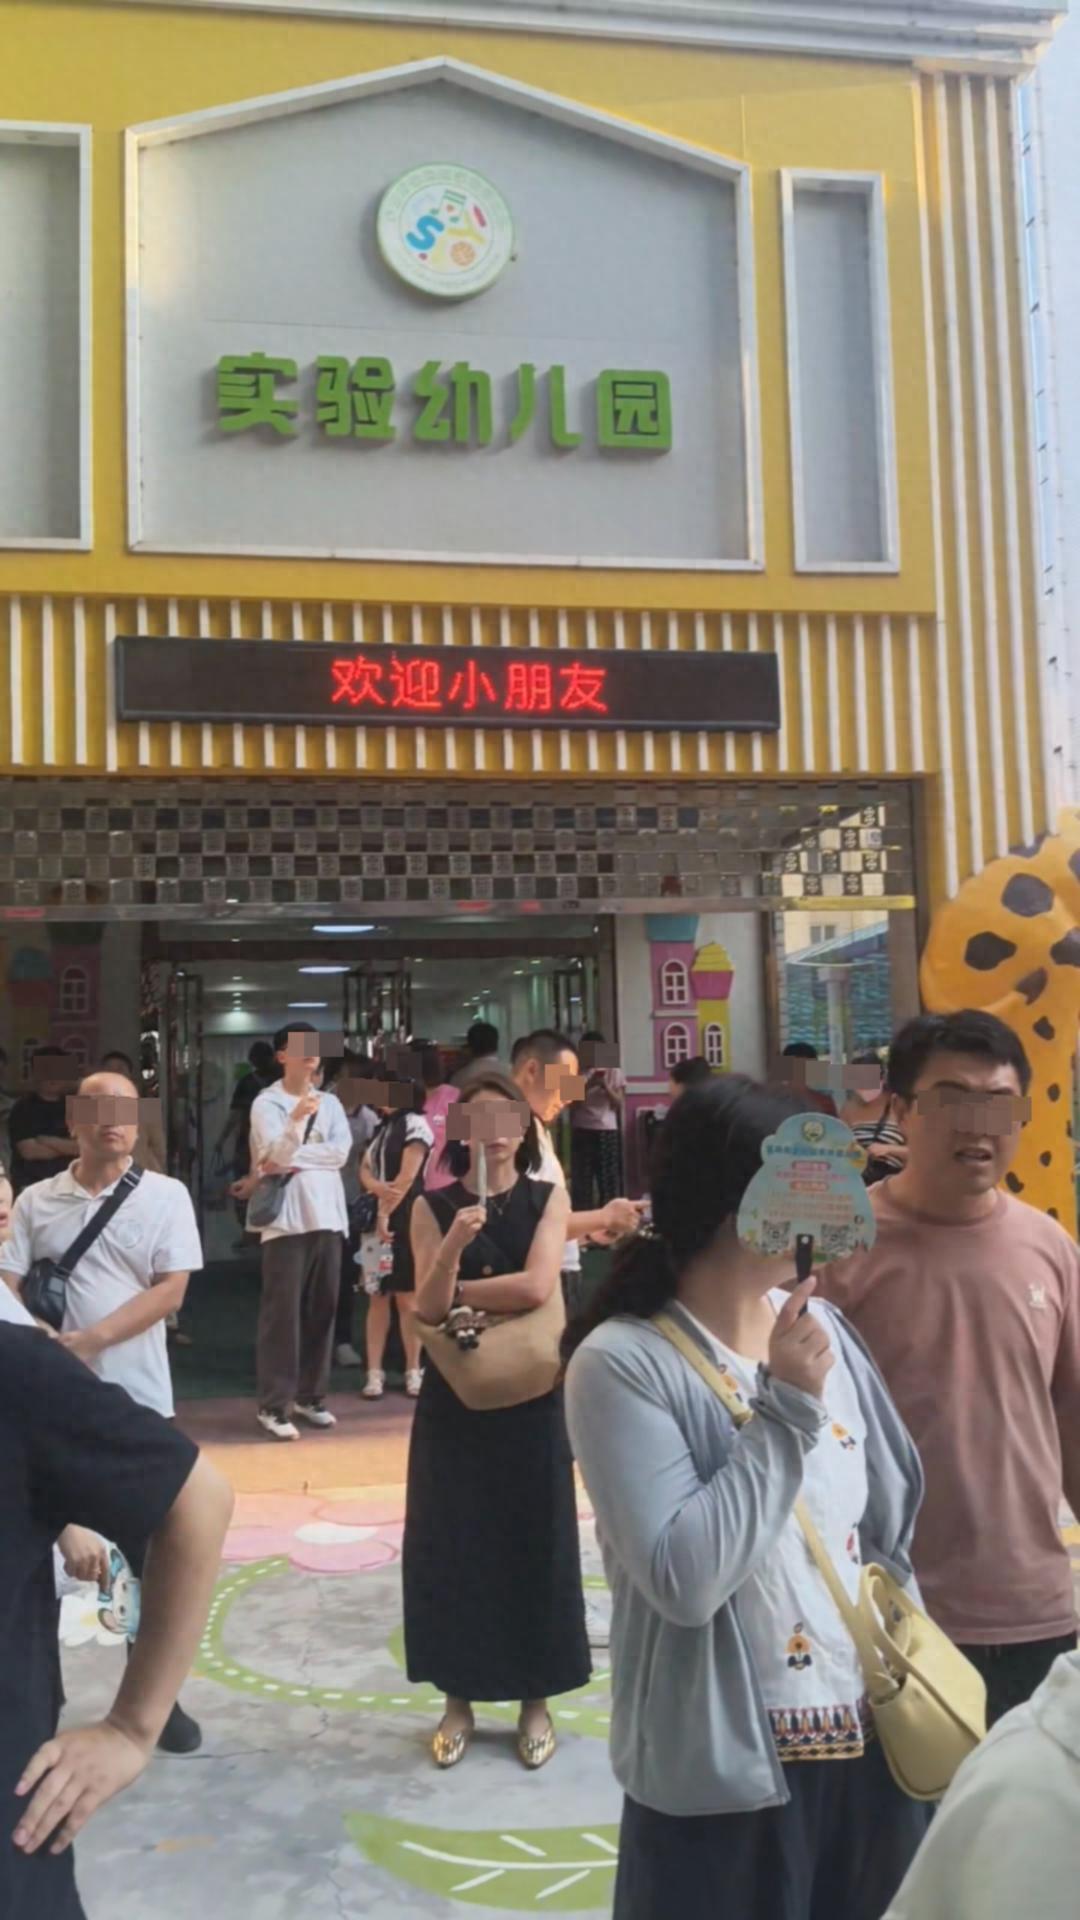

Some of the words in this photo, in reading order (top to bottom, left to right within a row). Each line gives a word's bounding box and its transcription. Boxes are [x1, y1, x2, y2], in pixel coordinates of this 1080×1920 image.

[217, 352, 673, 451] 实验幼儿园
[330, 655, 608, 715] 欢迎小朋友
